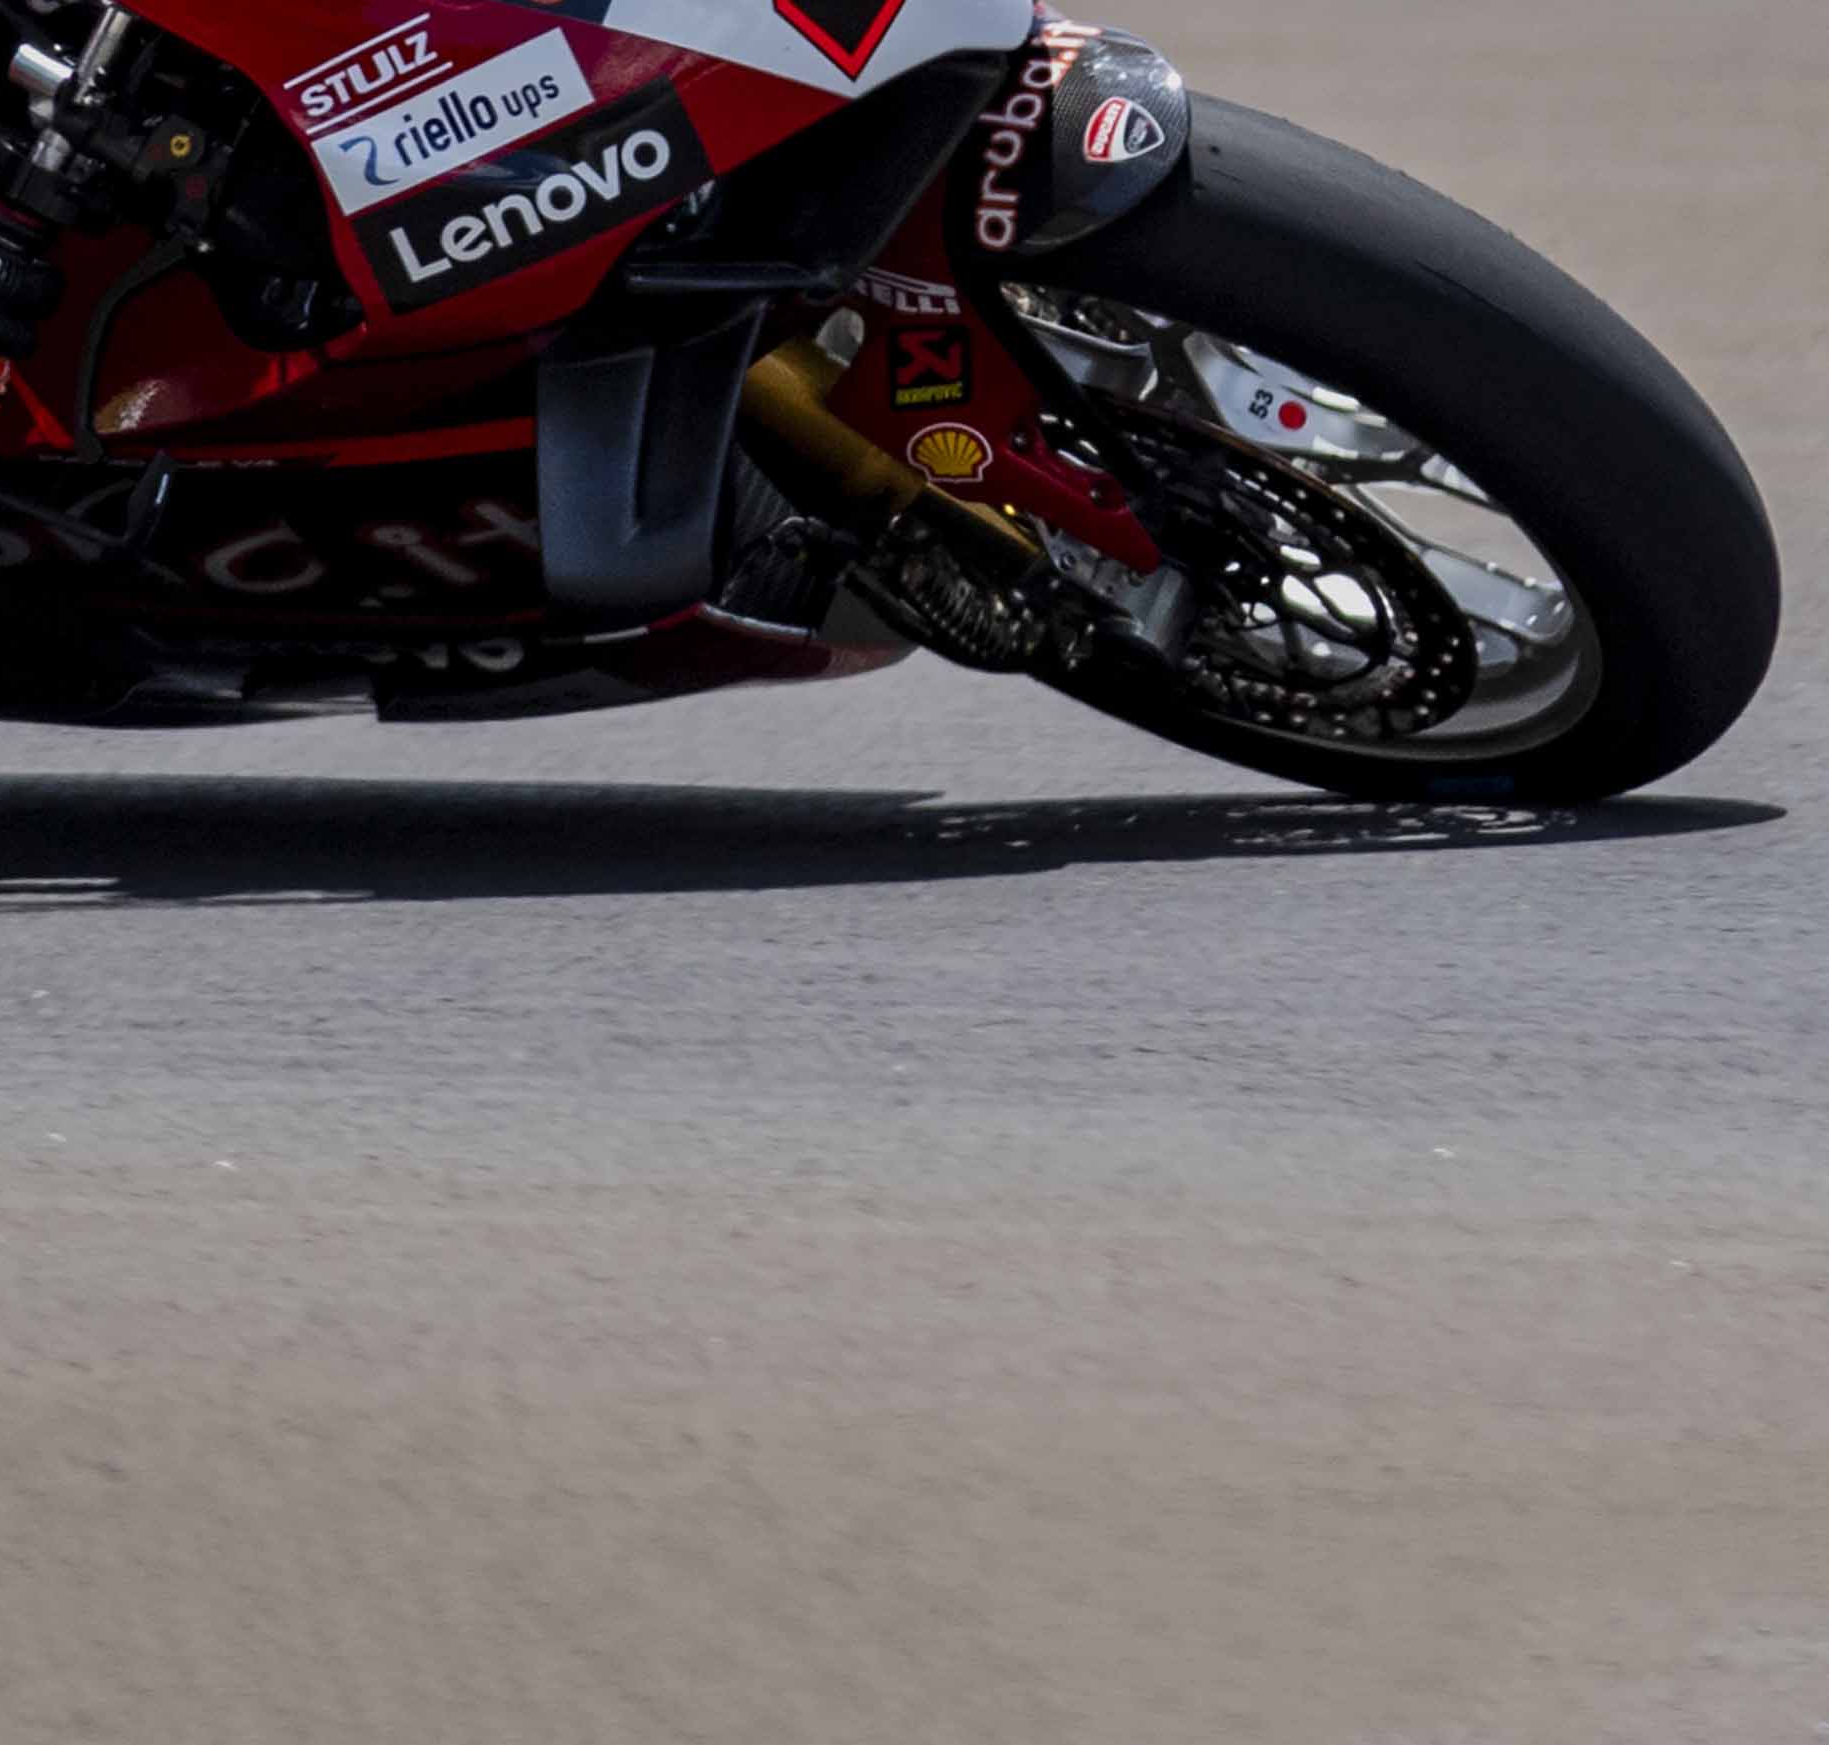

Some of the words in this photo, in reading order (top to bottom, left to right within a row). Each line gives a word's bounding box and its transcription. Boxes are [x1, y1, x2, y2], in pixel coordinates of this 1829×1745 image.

[300, 30, 439, 118] STULZ
[393, 86, 496, 170] riello
[501, 70, 561, 121] ups
[975, 20, 1104, 249] aruba.it
[390, 127, 672, 283] Lenovo
[1247, 389, 1274, 421] 53
